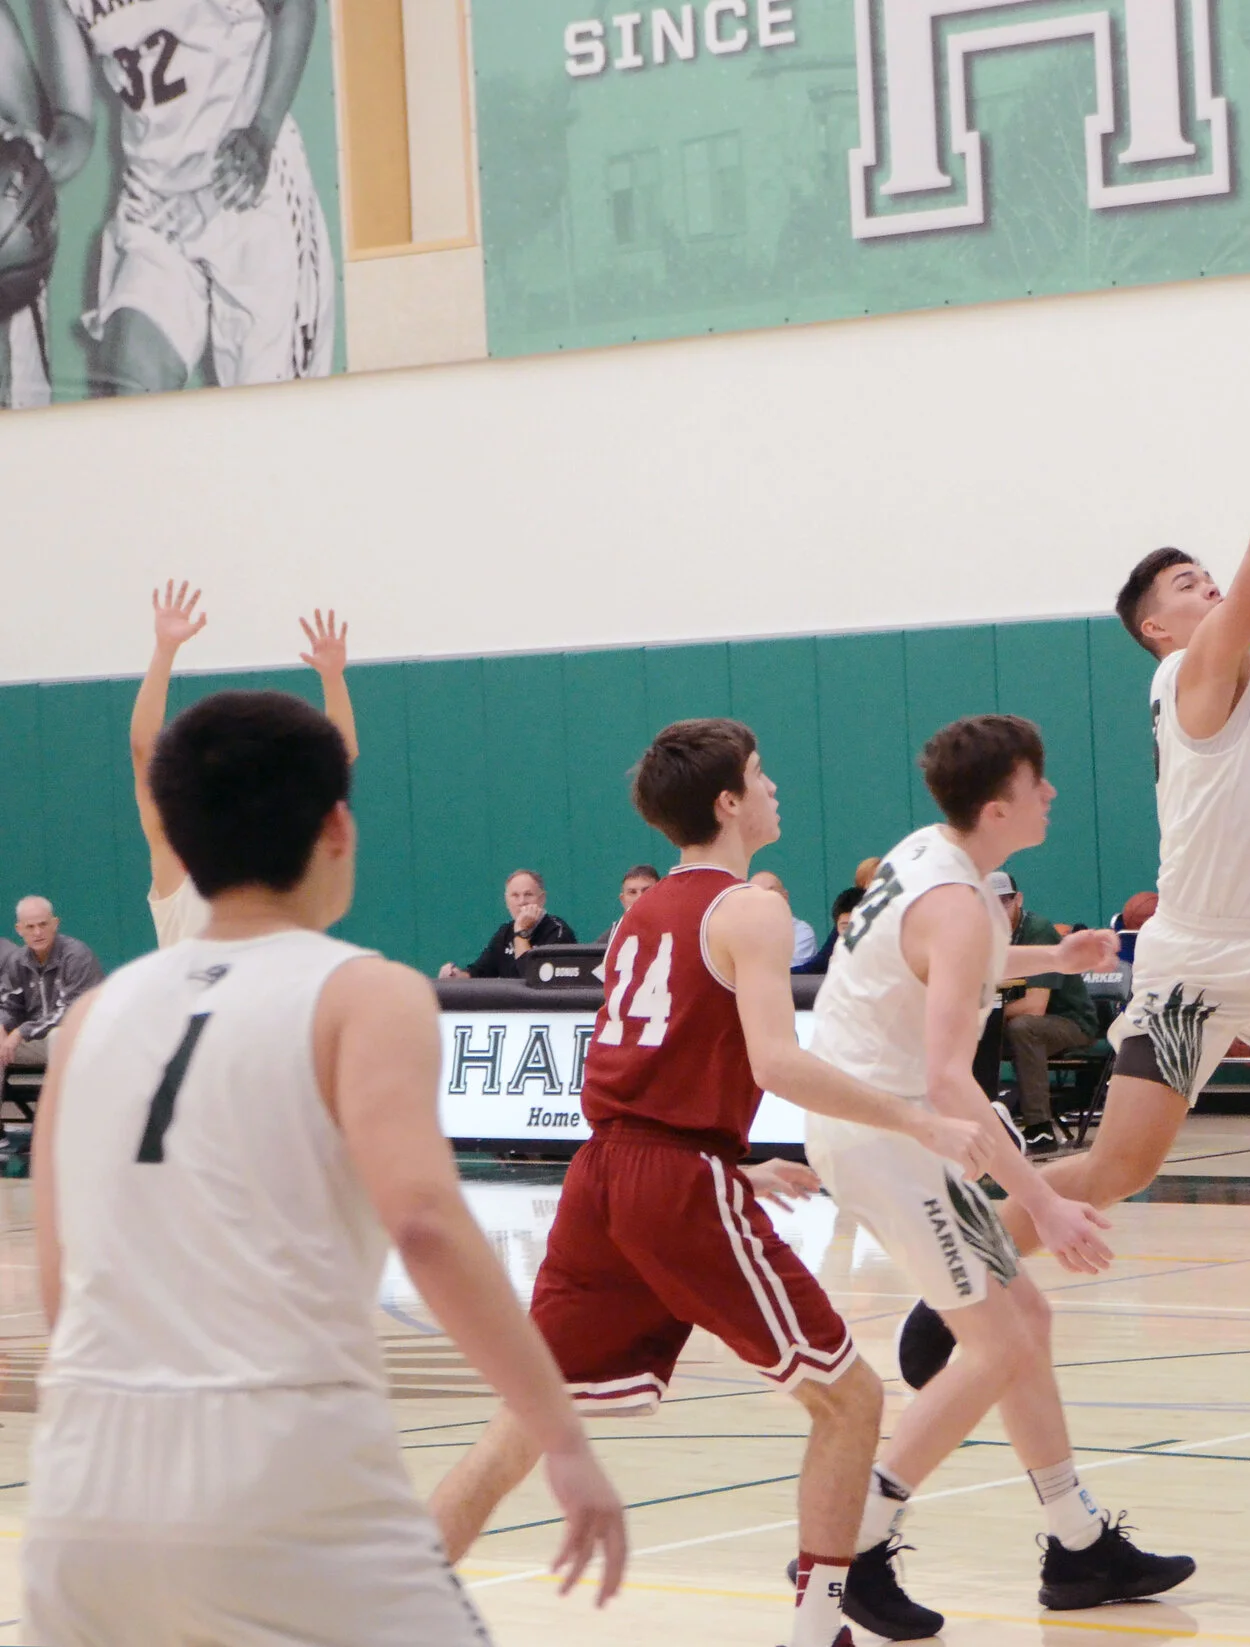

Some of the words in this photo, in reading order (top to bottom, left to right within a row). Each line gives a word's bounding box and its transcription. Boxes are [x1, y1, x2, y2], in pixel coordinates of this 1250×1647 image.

[113, 29, 187, 112] 32
[564, 0, 797, 77] SINCE
[597, 932, 674, 1047] 14
[136, 1011, 213, 1164] 1
[527, 1107, 580, 1127] Home
[923, 1197, 973, 1298] HARKER
